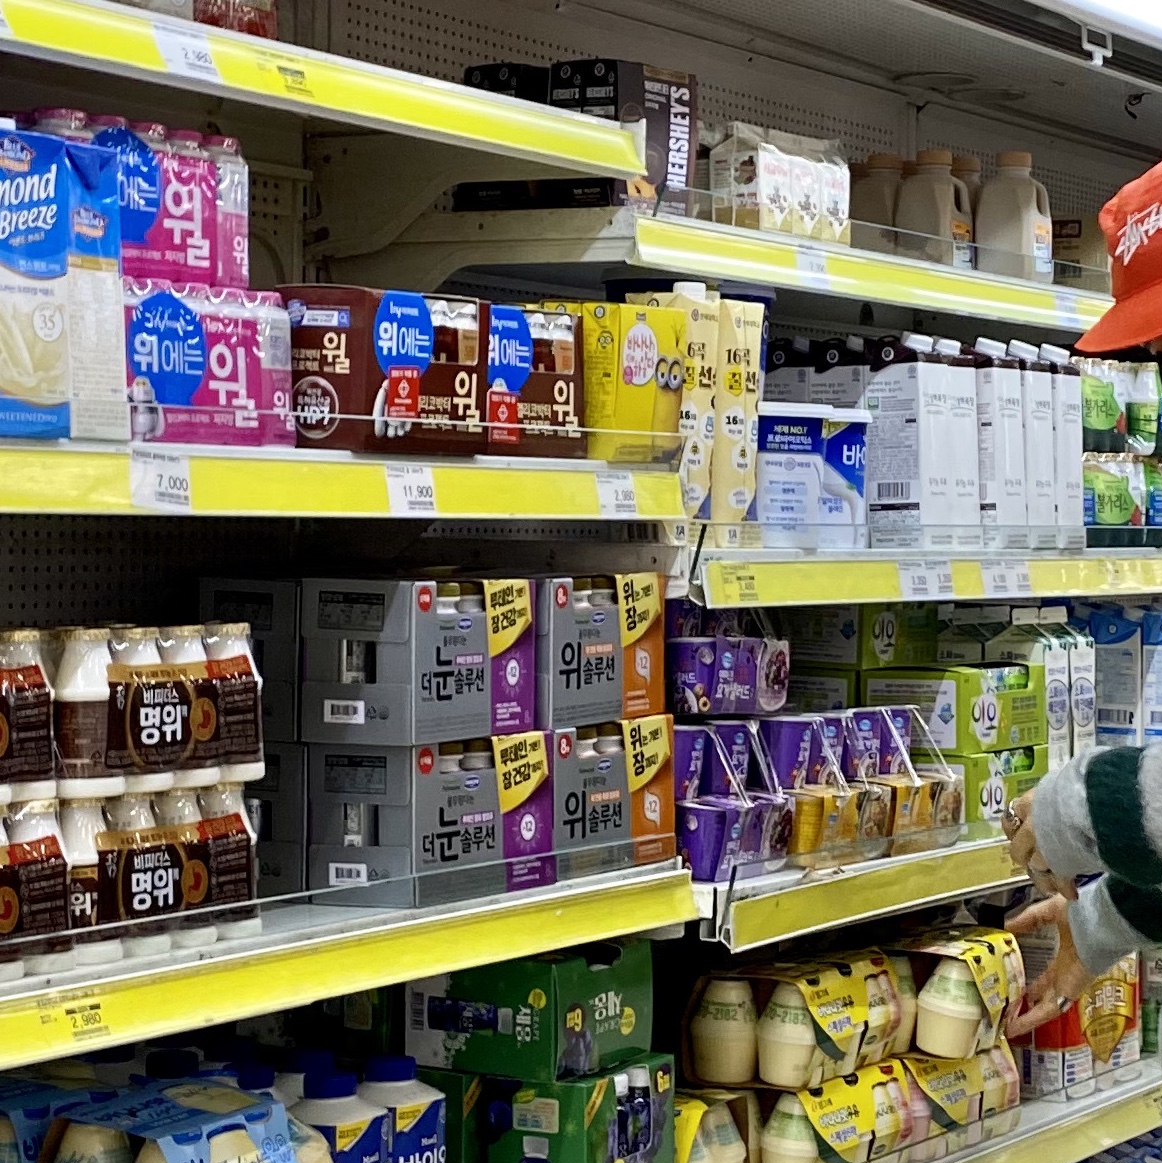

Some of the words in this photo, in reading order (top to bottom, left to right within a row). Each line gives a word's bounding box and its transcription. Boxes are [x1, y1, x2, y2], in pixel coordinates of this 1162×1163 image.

[666, 85, 690, 188] HERSHEY'S
[163, 181, 211, 268] 윌
[40, 315, 56, 331] 35
[322, 331, 350, 374] 윌
[208, 341, 259, 428] 윌
[453, 371, 483, 433] 윌
[553, 379, 582, 438] 윌
[156, 474, 189, 492] 7,000
[403, 485, 433, 500] 11,900
[72, 1012, 102, 1029] 2,980
